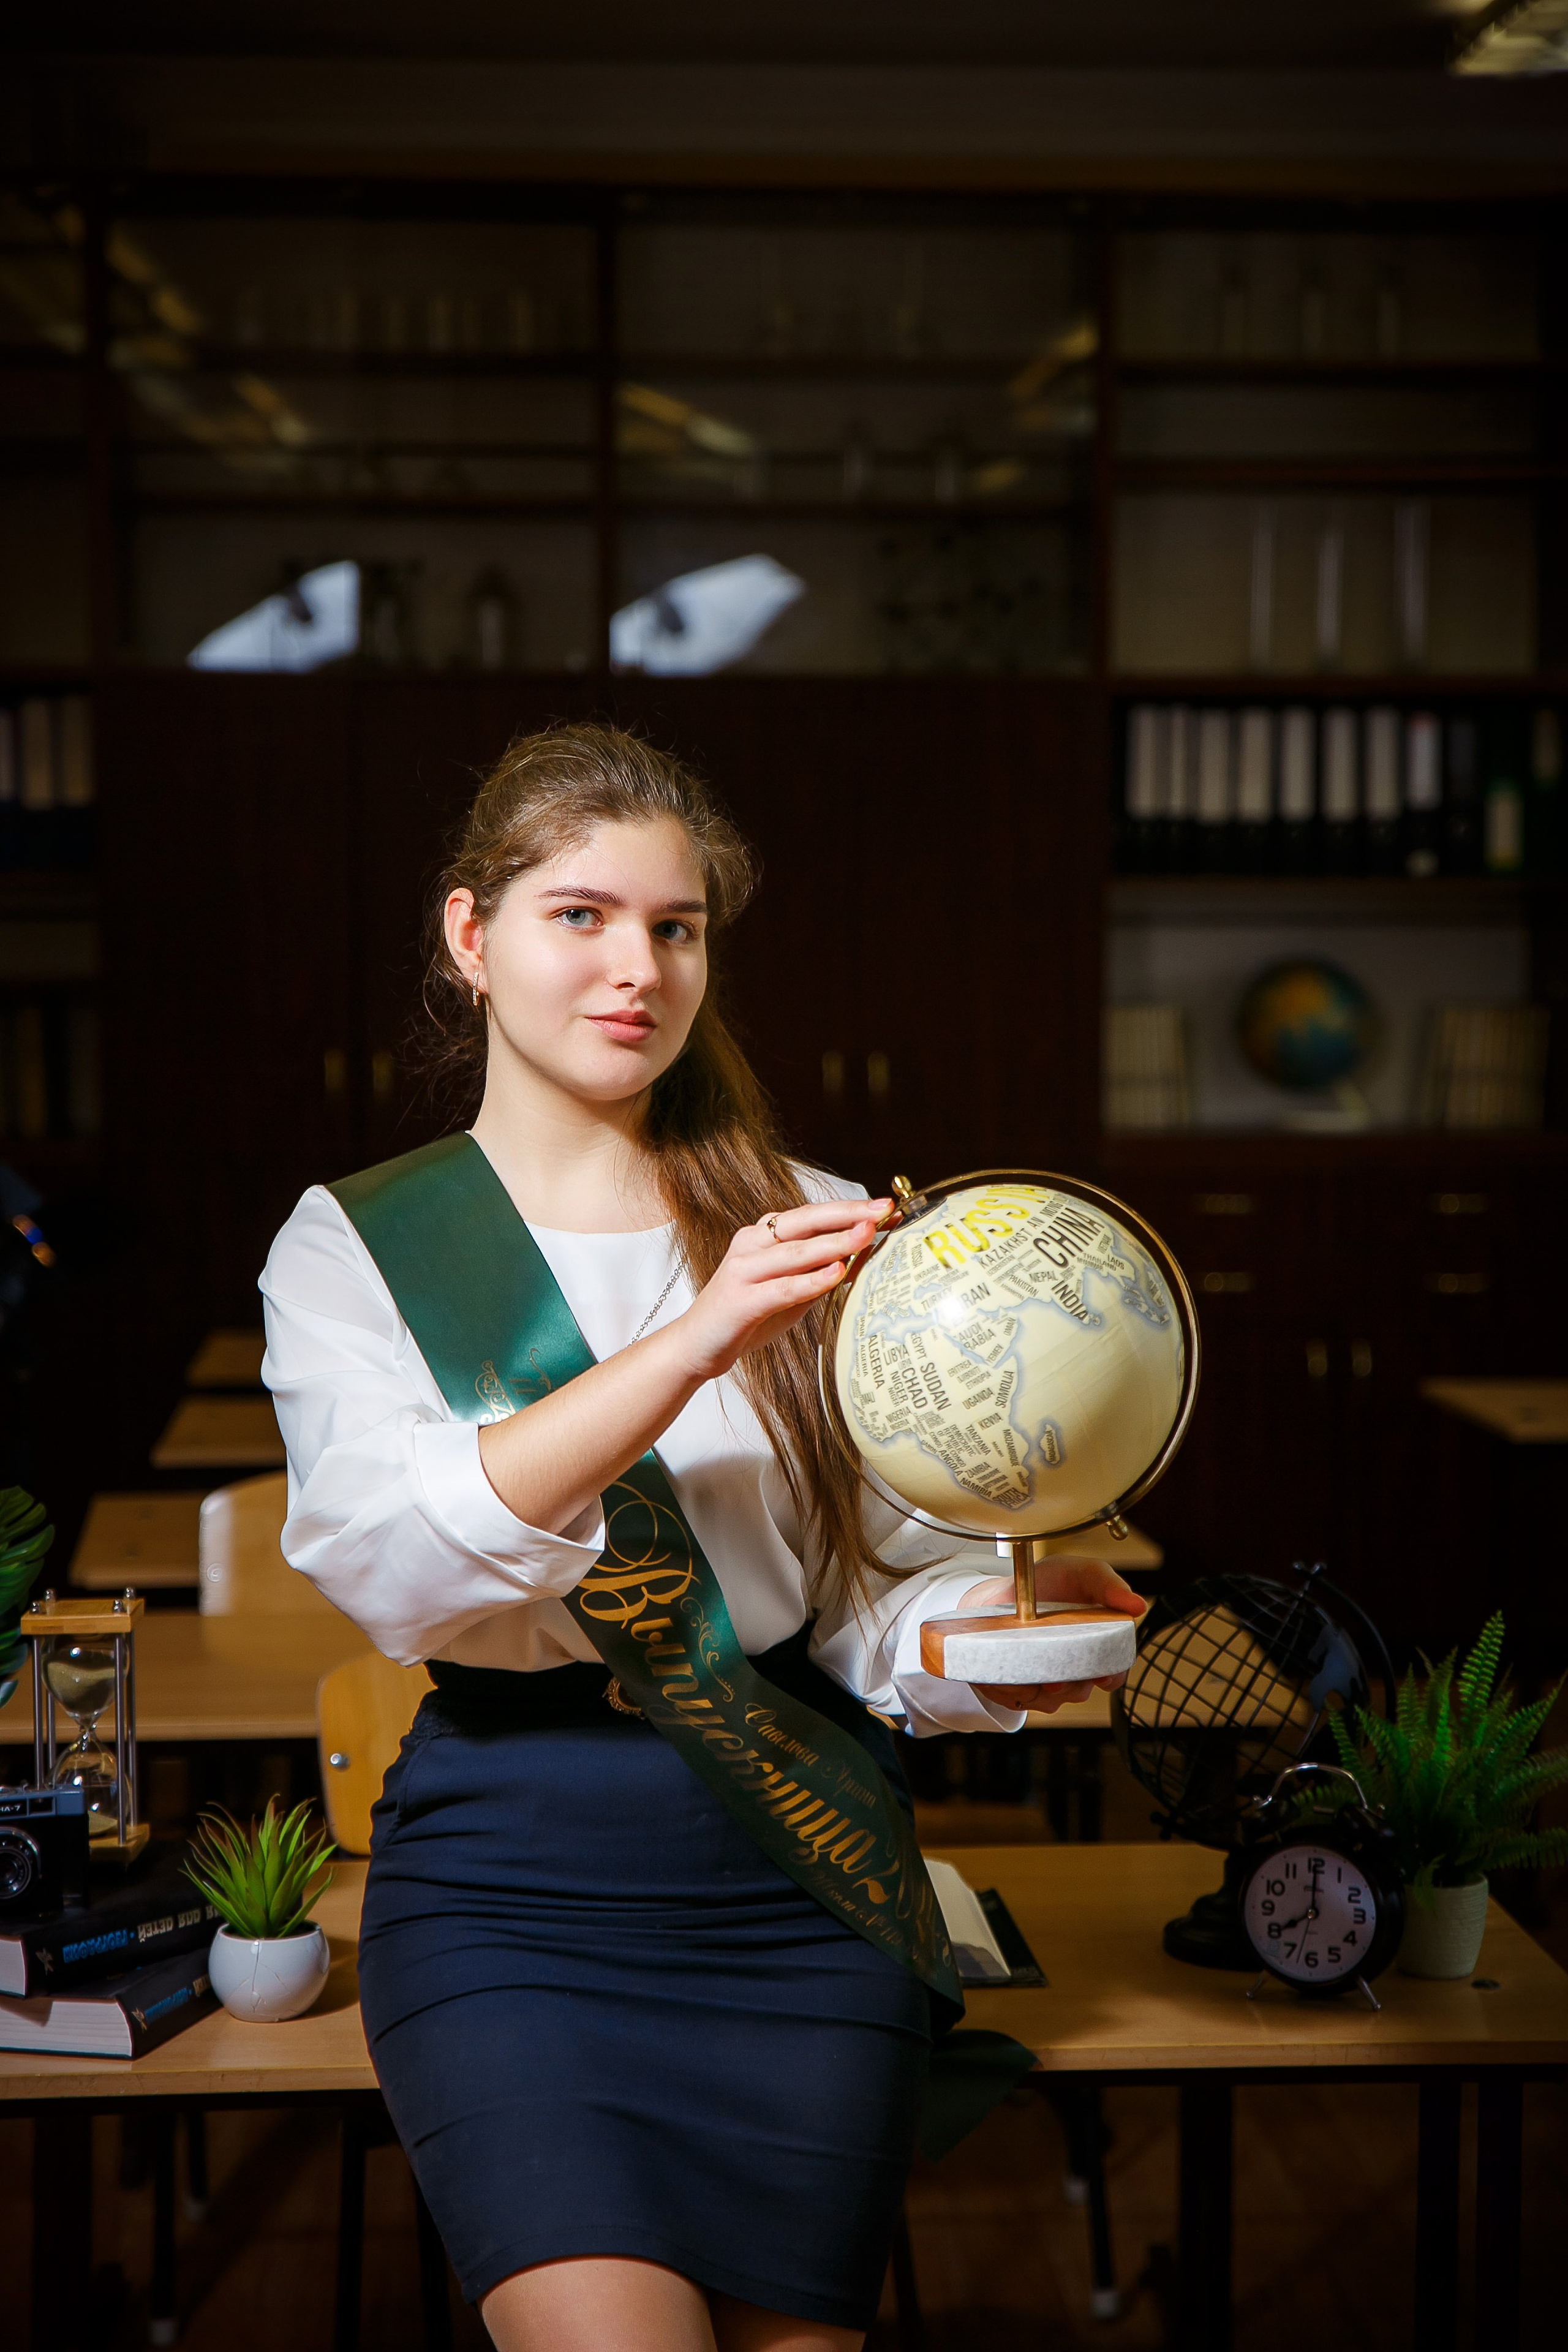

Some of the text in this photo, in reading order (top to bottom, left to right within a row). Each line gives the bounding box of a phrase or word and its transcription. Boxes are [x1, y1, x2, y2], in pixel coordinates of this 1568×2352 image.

[924, 1186, 1050, 1270] RUSSIA
[1033, 1207, 1105, 1269] CHINA
[911, 1244, 924, 1268] RUSSIA
[1083, 1253, 1117, 1272] THAILAND
[1107, 1254, 1125, 1270] LAOS
[1010, 1275, 1039, 1297] PAKISTAN
[1028, 1270, 1059, 1283] NEPAL
[960, 1283, 990, 1309] RAN
[1051, 1280, 1089, 1322] INDIA
[959, 1321, 982, 1341] AUDI
[1004, 1318, 1016, 1336] OMAN
[911, 1333, 927, 1359] EGYPT
[964, 1329, 996, 1350] RABIA
[869, 1335, 885, 1389] ALGERIA
[986, 1344, 1003, 1363] YEMEN
[891, 1371, 908, 1404] NIGER
[902, 1368, 928, 1409] CHAD
[921, 1362, 951, 1411] SUDAN
[888, 1387, 900, 1407] NIGER
[962, 1388, 993, 1409] UGANDA
[886, 1406, 912, 1423] NIGERIA
[979, 1413, 1003, 1430] KENYA
[921, 1439, 937, 1454] GABON
[929, 1431, 943, 1447] CONGO
[937, 1430, 944, 1439] OF
[950, 1449, 967, 1468] CONGO
[943, 1427, 965, 1454] REPUBLIC
[950, 1424, 976, 1457] DEMOCRATIC
[965, 1424, 992, 1456] TANZANIA
[1003, 1429, 1020, 1467] MOZAMBIQUE
[938, 1449, 963, 1477] ANGOLA
[965, 1462, 992, 1478] ZAMBIA
[960, 1477, 993, 1497] NAMIBIA
[576, 1480, 872, 1874] Выпускница
[745, 1703, 820, 1767] Савелова
[1286, 1863, 1297, 1879] 11
[1308, 1858, 1325, 1874] 12
[1337, 1868, 1342, 1883] 1
[1266, 1880, 1285, 1896] 10
[1348, 1887, 1361, 1904] 2
[1262, 1900, 1275, 1916] 9
[1354, 1908, 1366, 1924] 3
[137, 1917, 174, 1944] ДЕТЕЙ
[178, 1912, 201, 1930] ДЛЯ
[1268, 1923, 1281, 1939] 8
[63, 1929, 129, 1964] ГЕОГРАФИЯ
[1343, 1931, 1357, 1947] 4
[1284, 1942, 1297, 1958] 7
[1305, 1952, 1319, 1968] 6
[1328, 1947, 1341, 1963] 5
